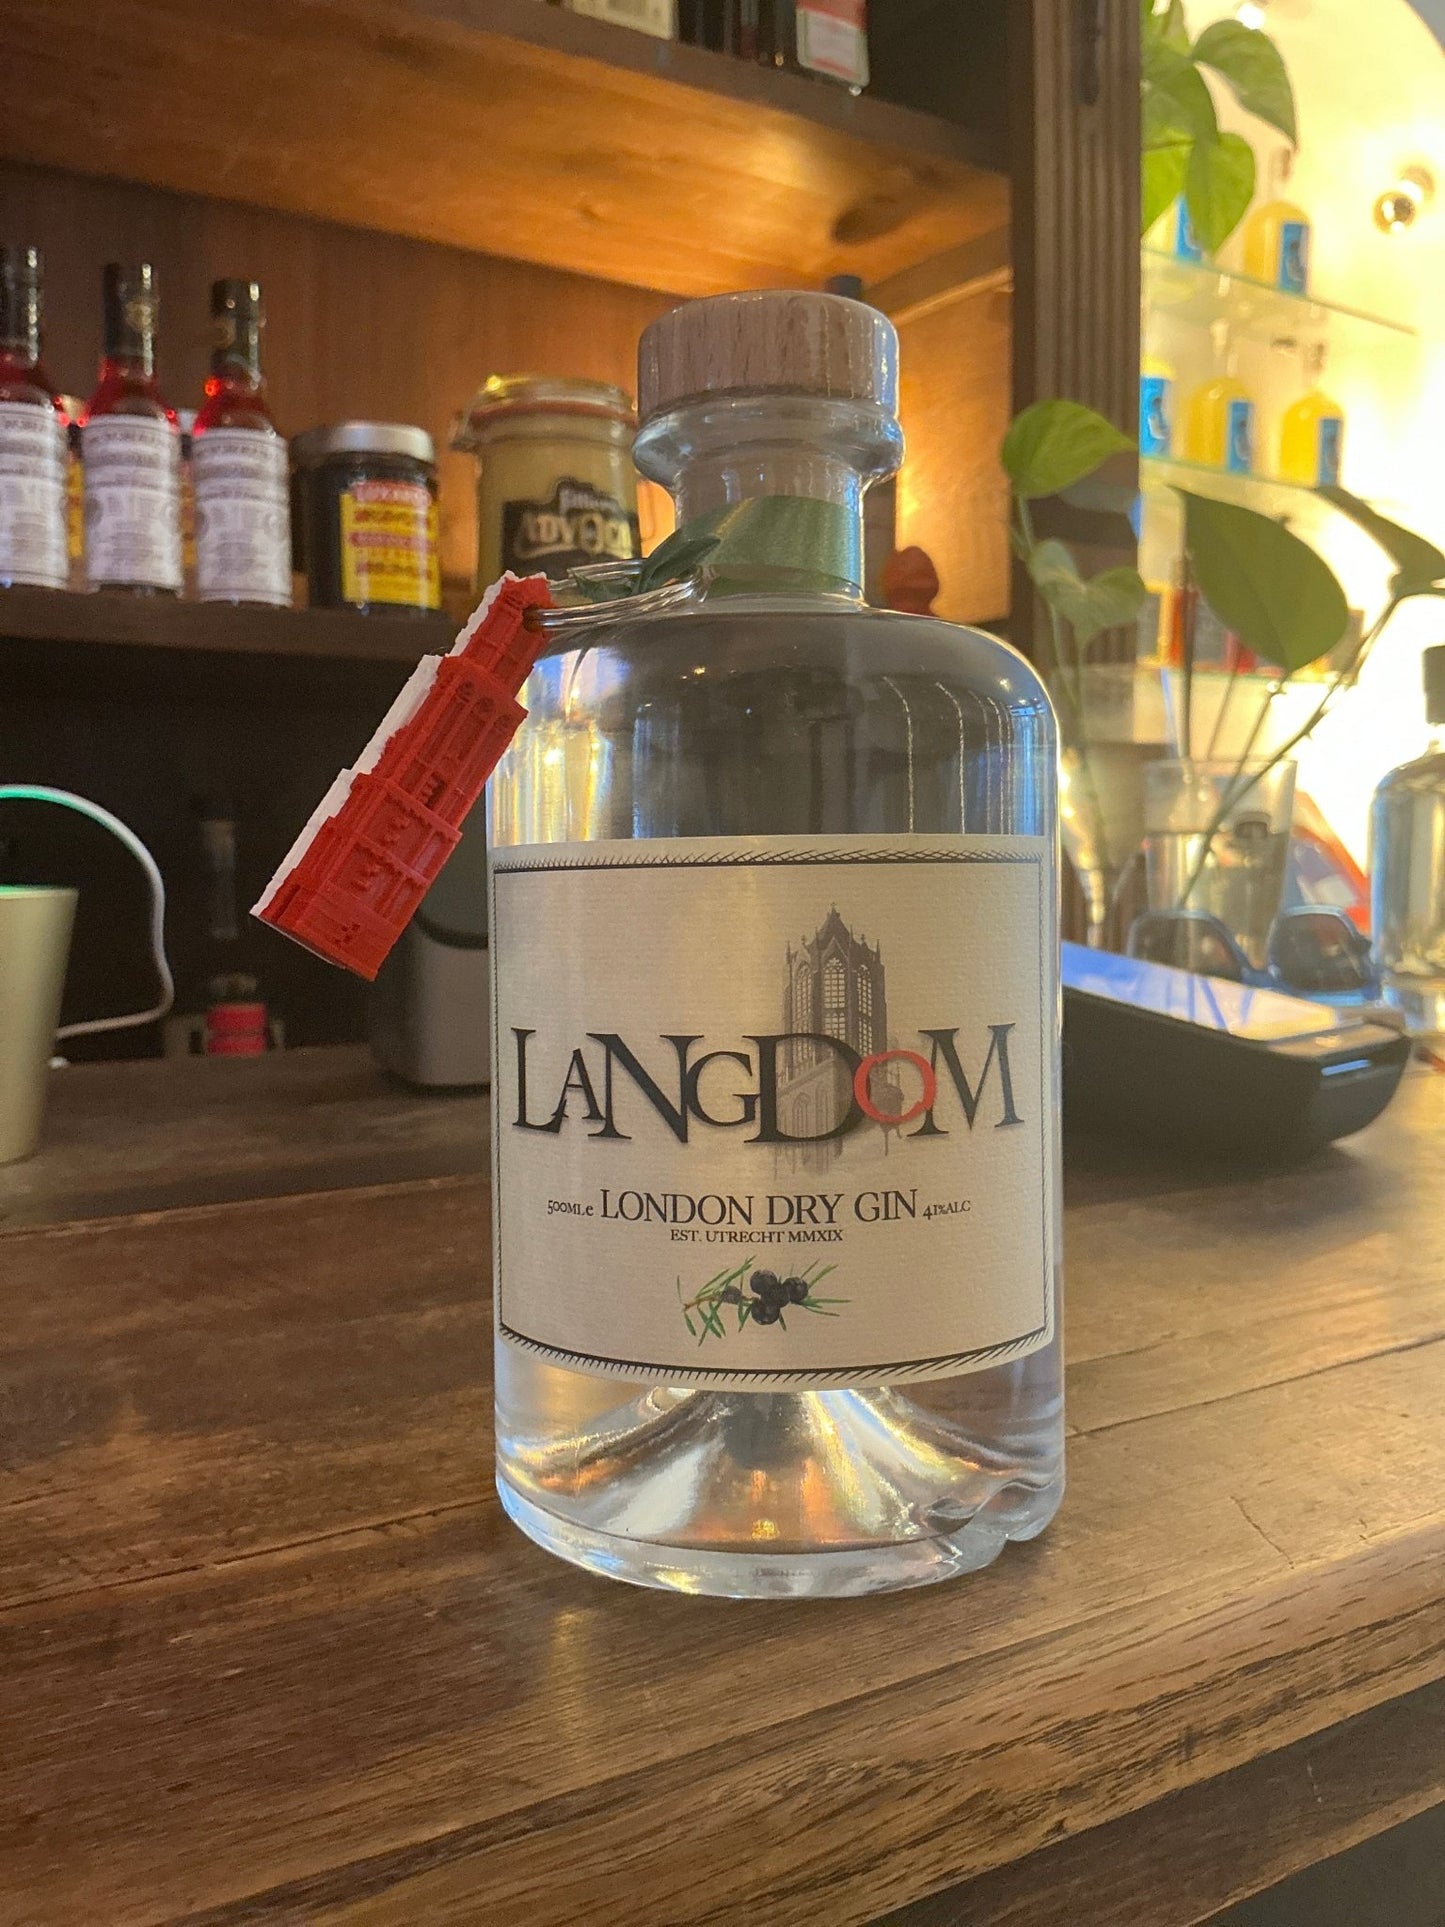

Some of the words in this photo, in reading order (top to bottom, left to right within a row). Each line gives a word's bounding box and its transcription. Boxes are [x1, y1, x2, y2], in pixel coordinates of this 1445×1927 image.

[511, 1022, 1025, 1143] LANGDOM
[600, 1188, 755, 1225] LONDON
[766, 1194, 845, 1225] DRY
[854, 1189, 919, 1222] GIN
[670, 1229, 702, 1242] EST.
[706, 1230, 785, 1243] UTRECHT
[788, 1230, 844, 1243] MMXIX
